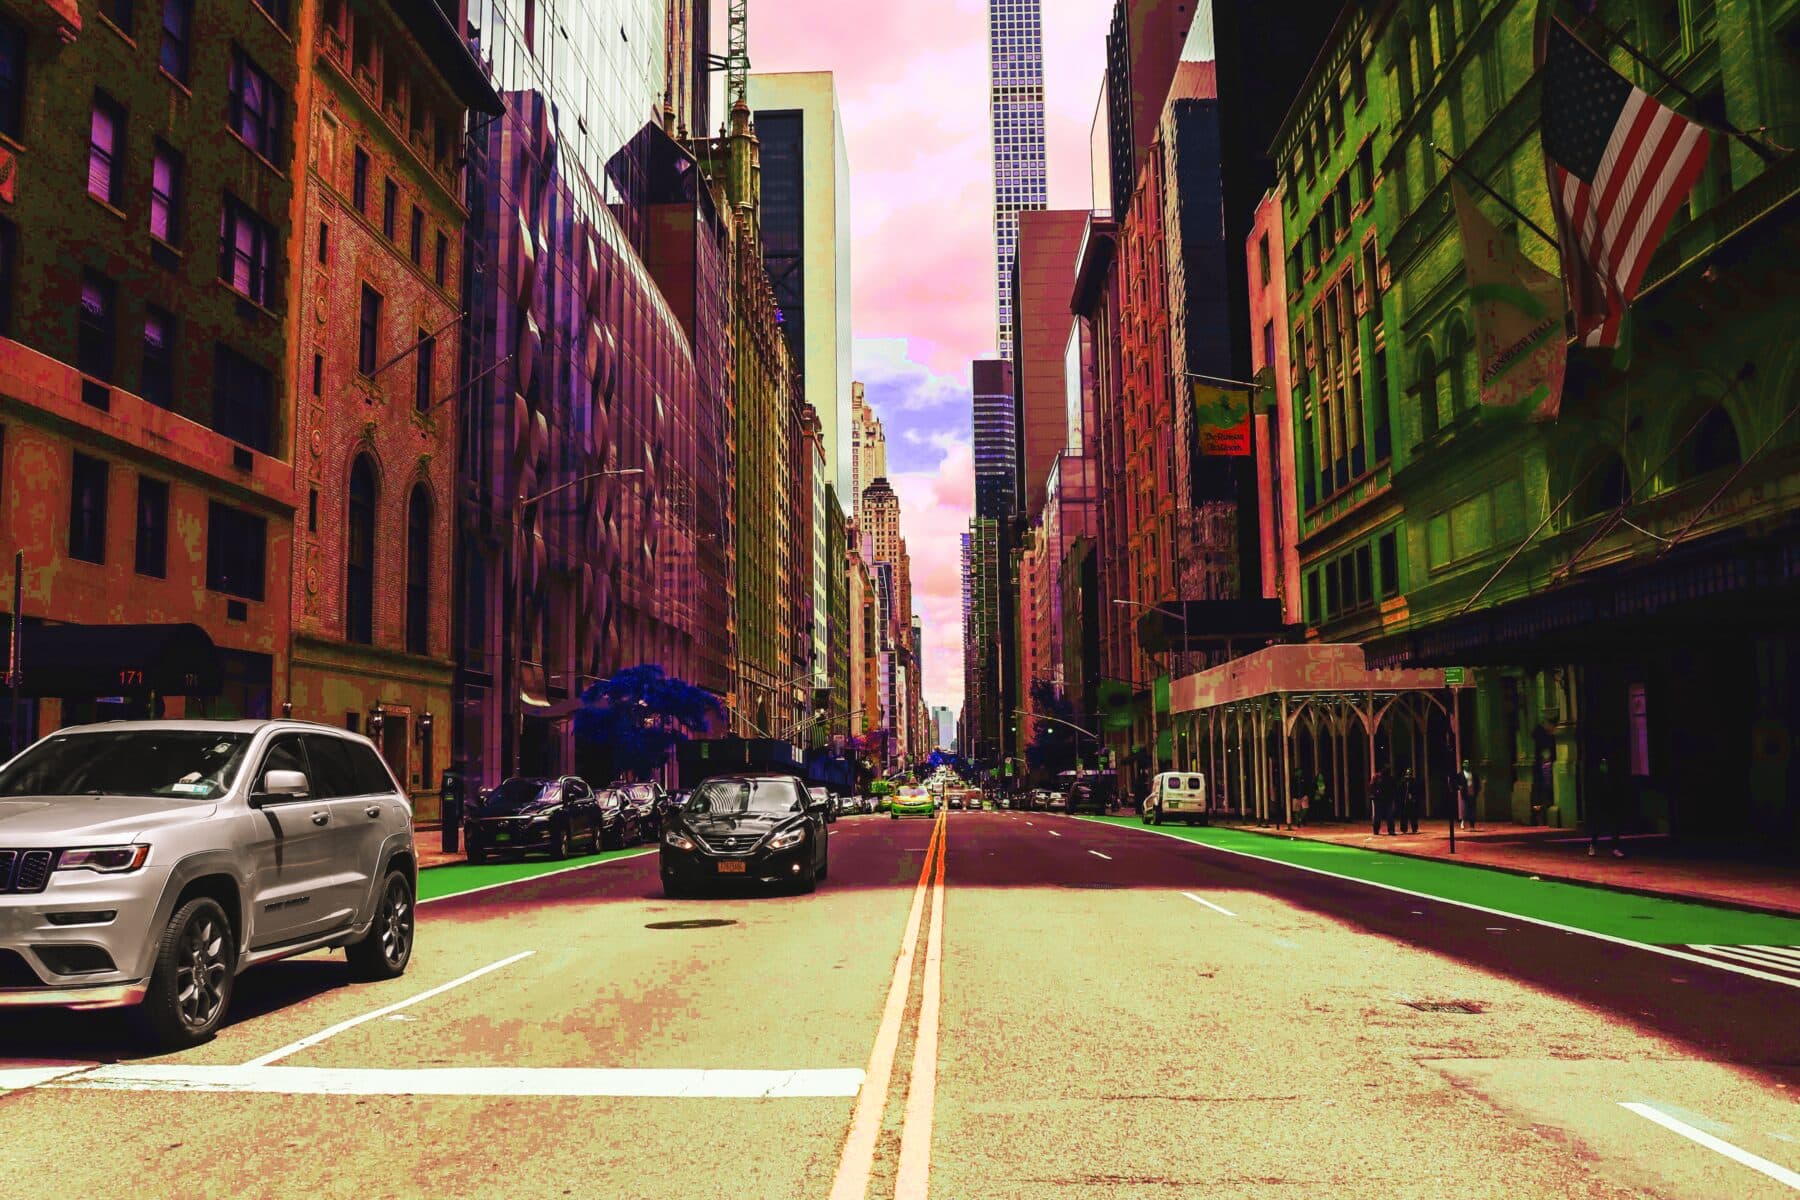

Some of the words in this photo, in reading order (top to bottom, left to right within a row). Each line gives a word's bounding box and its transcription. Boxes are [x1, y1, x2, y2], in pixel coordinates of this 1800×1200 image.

[1482, 337, 1528, 384] CARNEGIE
[1528, 318, 1554, 344] HALL
[120, 671, 143, 685] 171
